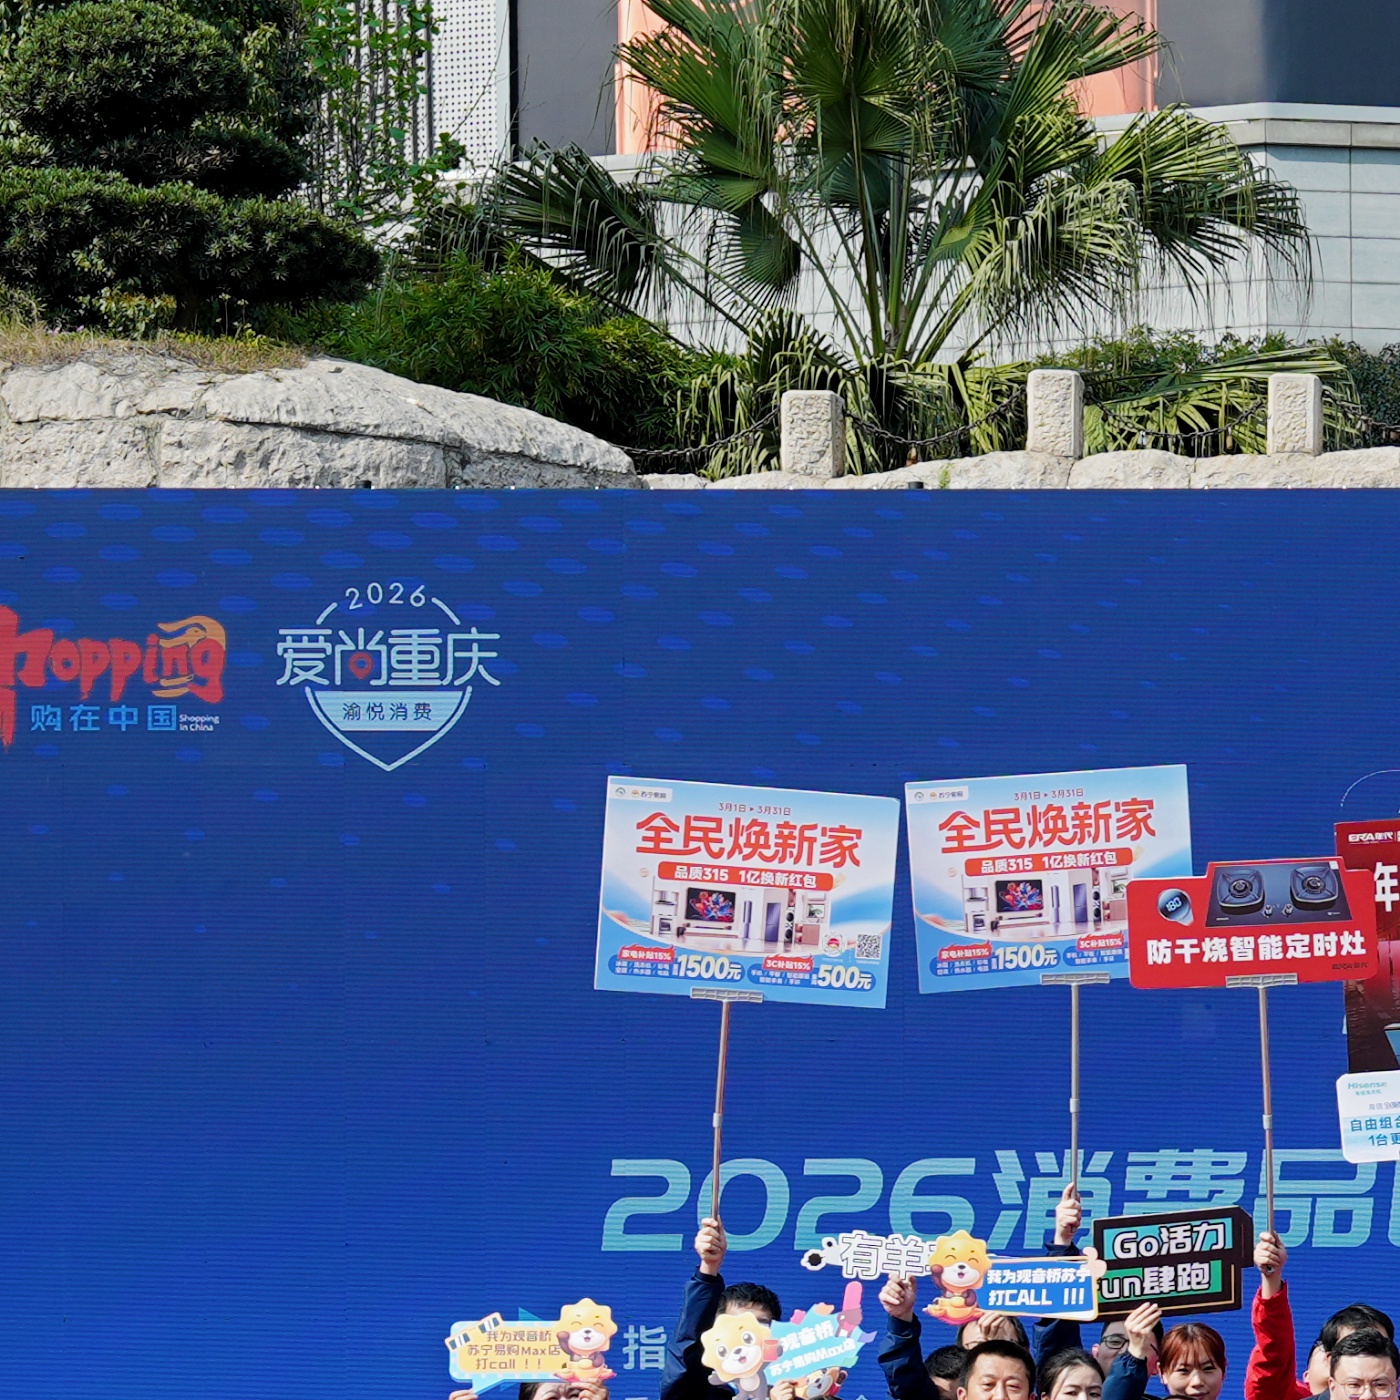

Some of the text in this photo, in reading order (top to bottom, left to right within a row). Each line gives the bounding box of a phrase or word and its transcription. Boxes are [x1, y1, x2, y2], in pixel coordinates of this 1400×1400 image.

[345, 582, 427, 610] 2026
[0, 605, 226, 708] hopping
[276, 627, 501, 686] 爱尚重庆
[30, 703, 178, 732] 购在中国
[179, 714, 220, 725] Shopping
[342, 702, 433, 723] 渝悦消费
[1014, 788, 1084, 801] 3月1日 3月31日
[718, 802, 792, 816] 3月1日 3月31日
[938, 798, 1156, 854] 全民焕新家
[636, 811, 863, 868] 全民焕新家
[980, 851, 1117, 873] 品质315 1亿换新红包
[674, 865, 817, 888] 品质315 1亿换新红包
[994, 944, 1057, 970] 1500元
[1146, 930, 1367, 966] 防干烧智能定时灶
[676, 954, 742, 981] 1500元
[766, 958, 812, 971] 3C补贴15%
[817, 968, 872, 989] 500元
[1347, 1080, 1388, 1090] Hisense
[1112, 1222, 1226, 1261] Go活力
[987, 1267, 1092, 1285] 我为观音桥苏宁
[988, 1287, 1053, 1306] 打CALL
[486, 1330, 552, 1343] 我为观音桥
[779, 1319, 836, 1354] 观音桥
[467, 1343, 561, 1357] 苏宁易购Max店
